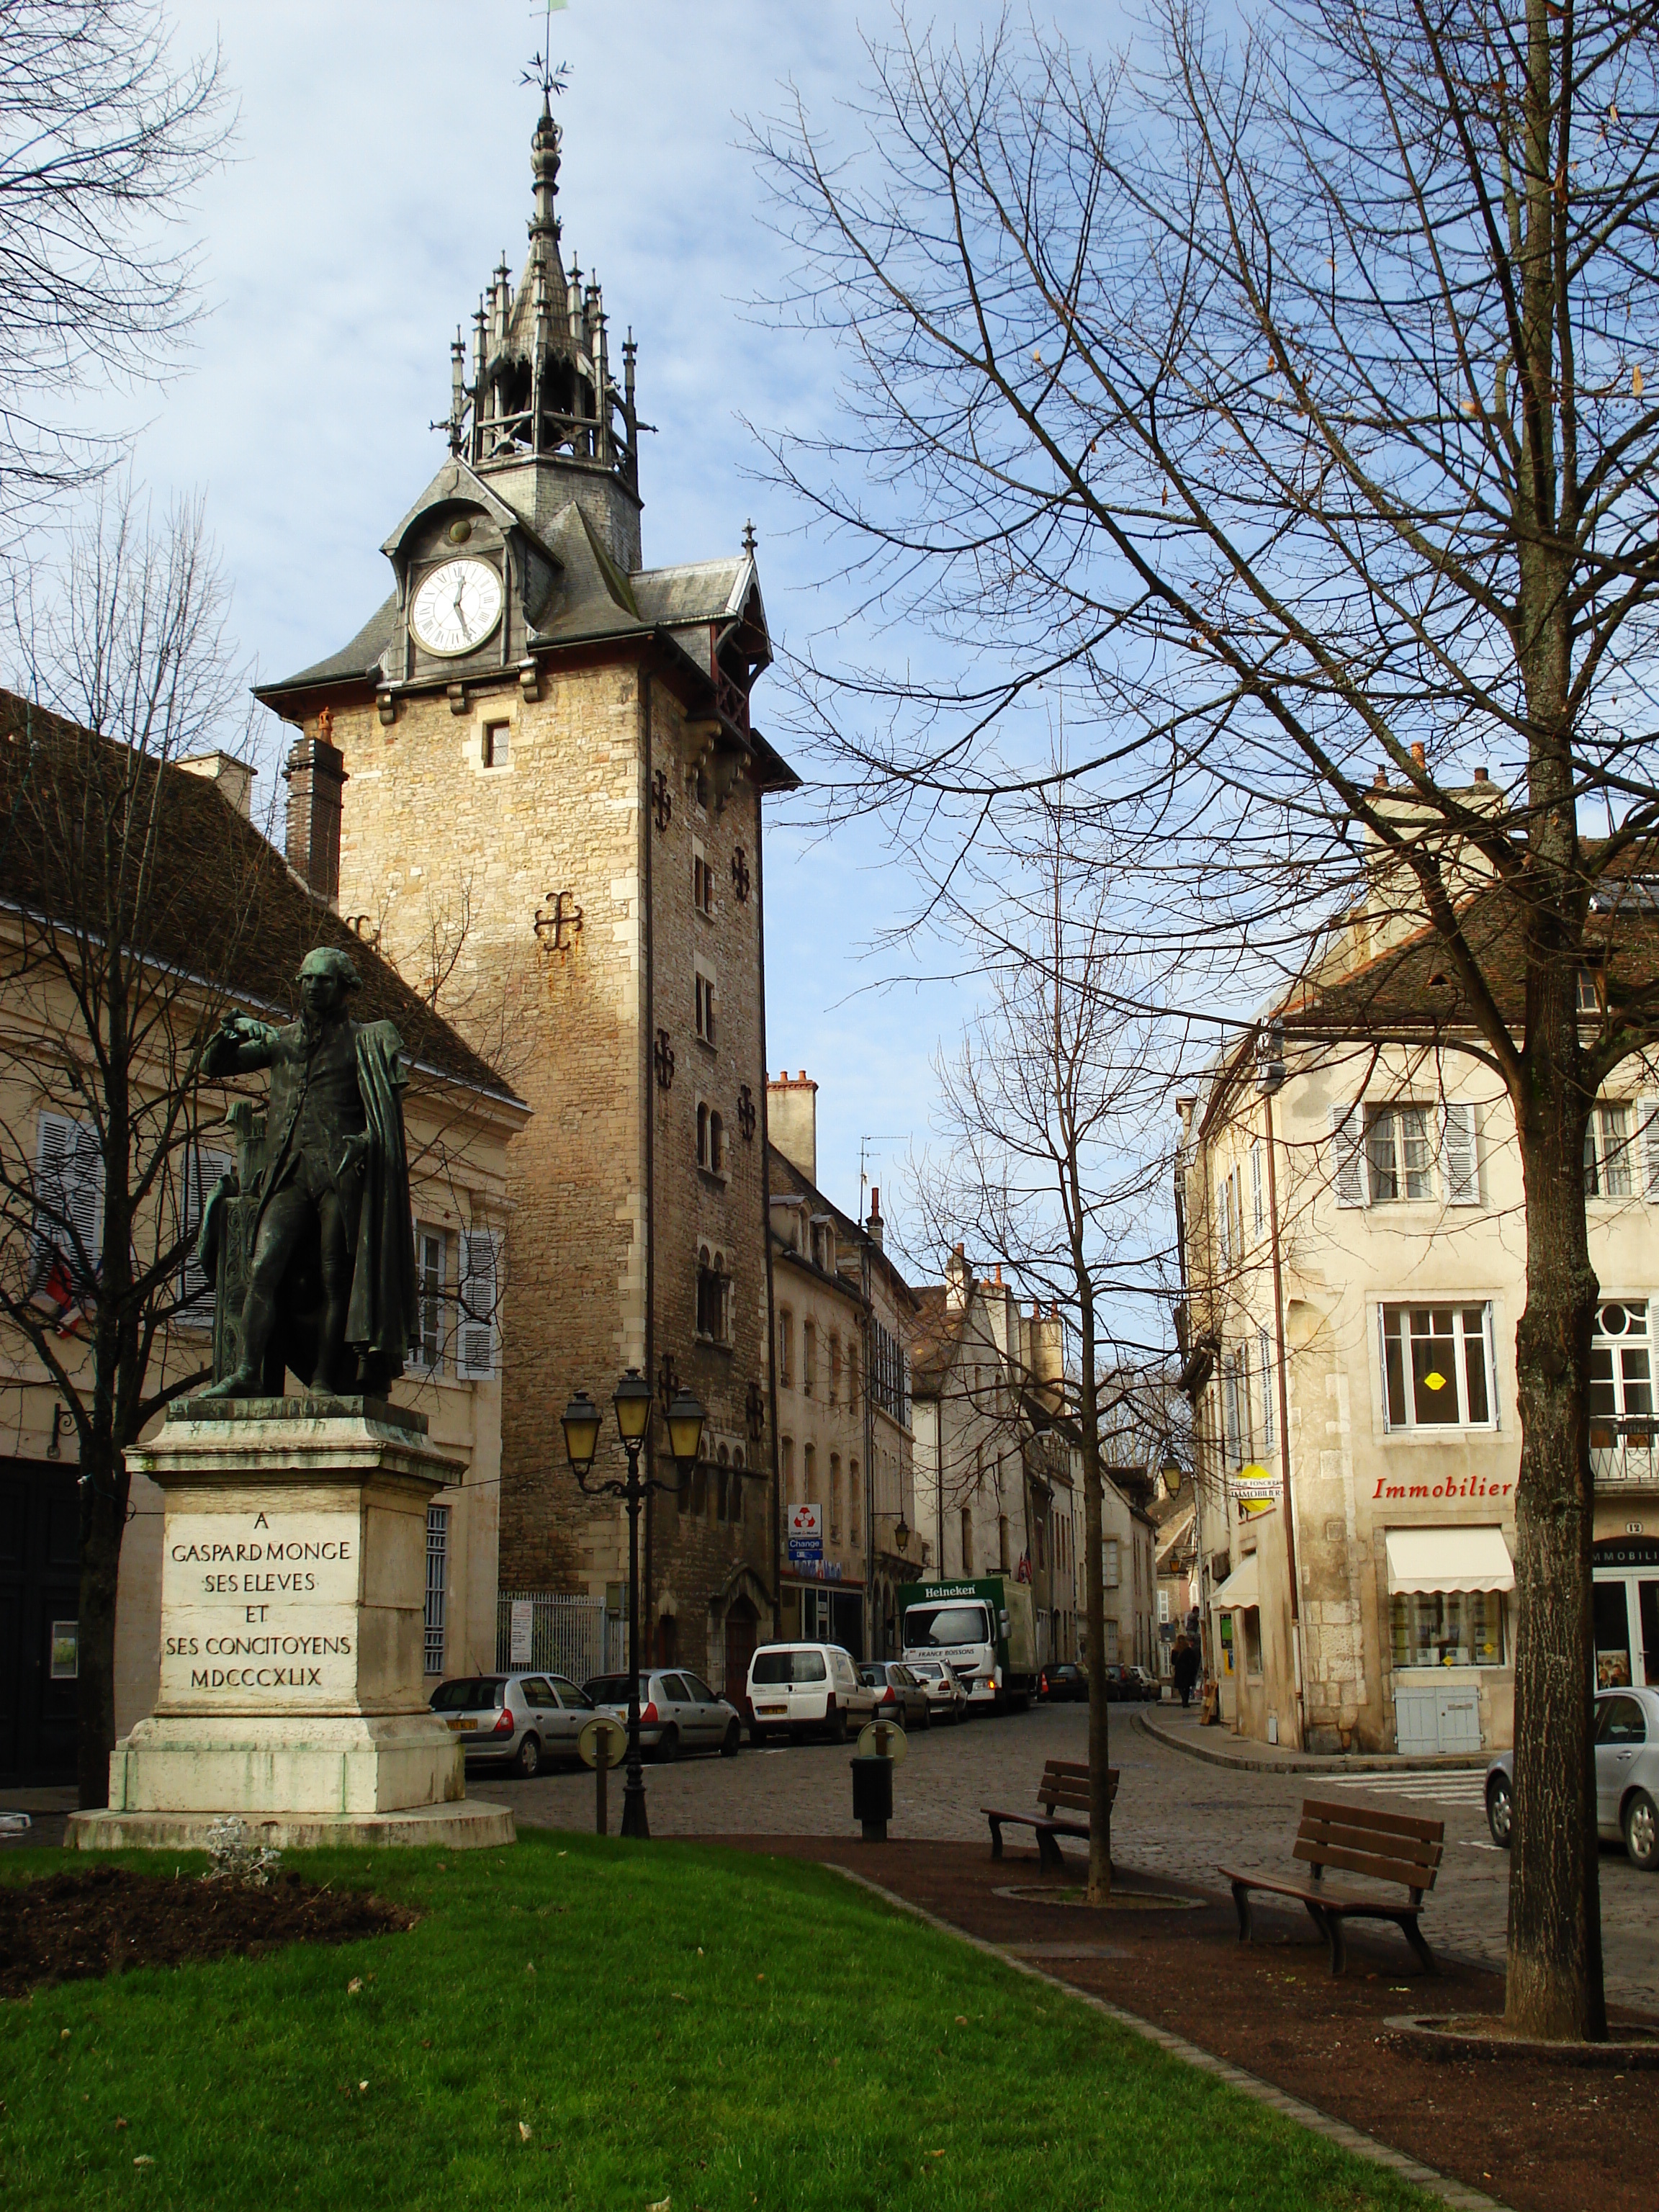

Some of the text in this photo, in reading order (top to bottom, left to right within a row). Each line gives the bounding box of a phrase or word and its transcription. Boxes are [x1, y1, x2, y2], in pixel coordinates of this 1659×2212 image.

[1372, 1475, 1512, 1499] Immobilier
[253, 1512, 269, 1529] A
[1629, 1524, 1640, 1532] 12
[171, 1542, 351, 1562] GASPARD MONGE
[789, 1539, 820, 1549] Change
[204, 1573, 315, 1593] SES ELEVES
[925, 1585, 976, 1599] Heineken
[246, 1605, 269, 1623] ET
[166, 1636, 351, 1655] SES CONCITOYENS
[191, 1668, 322, 1688] MDCCCXLIX
